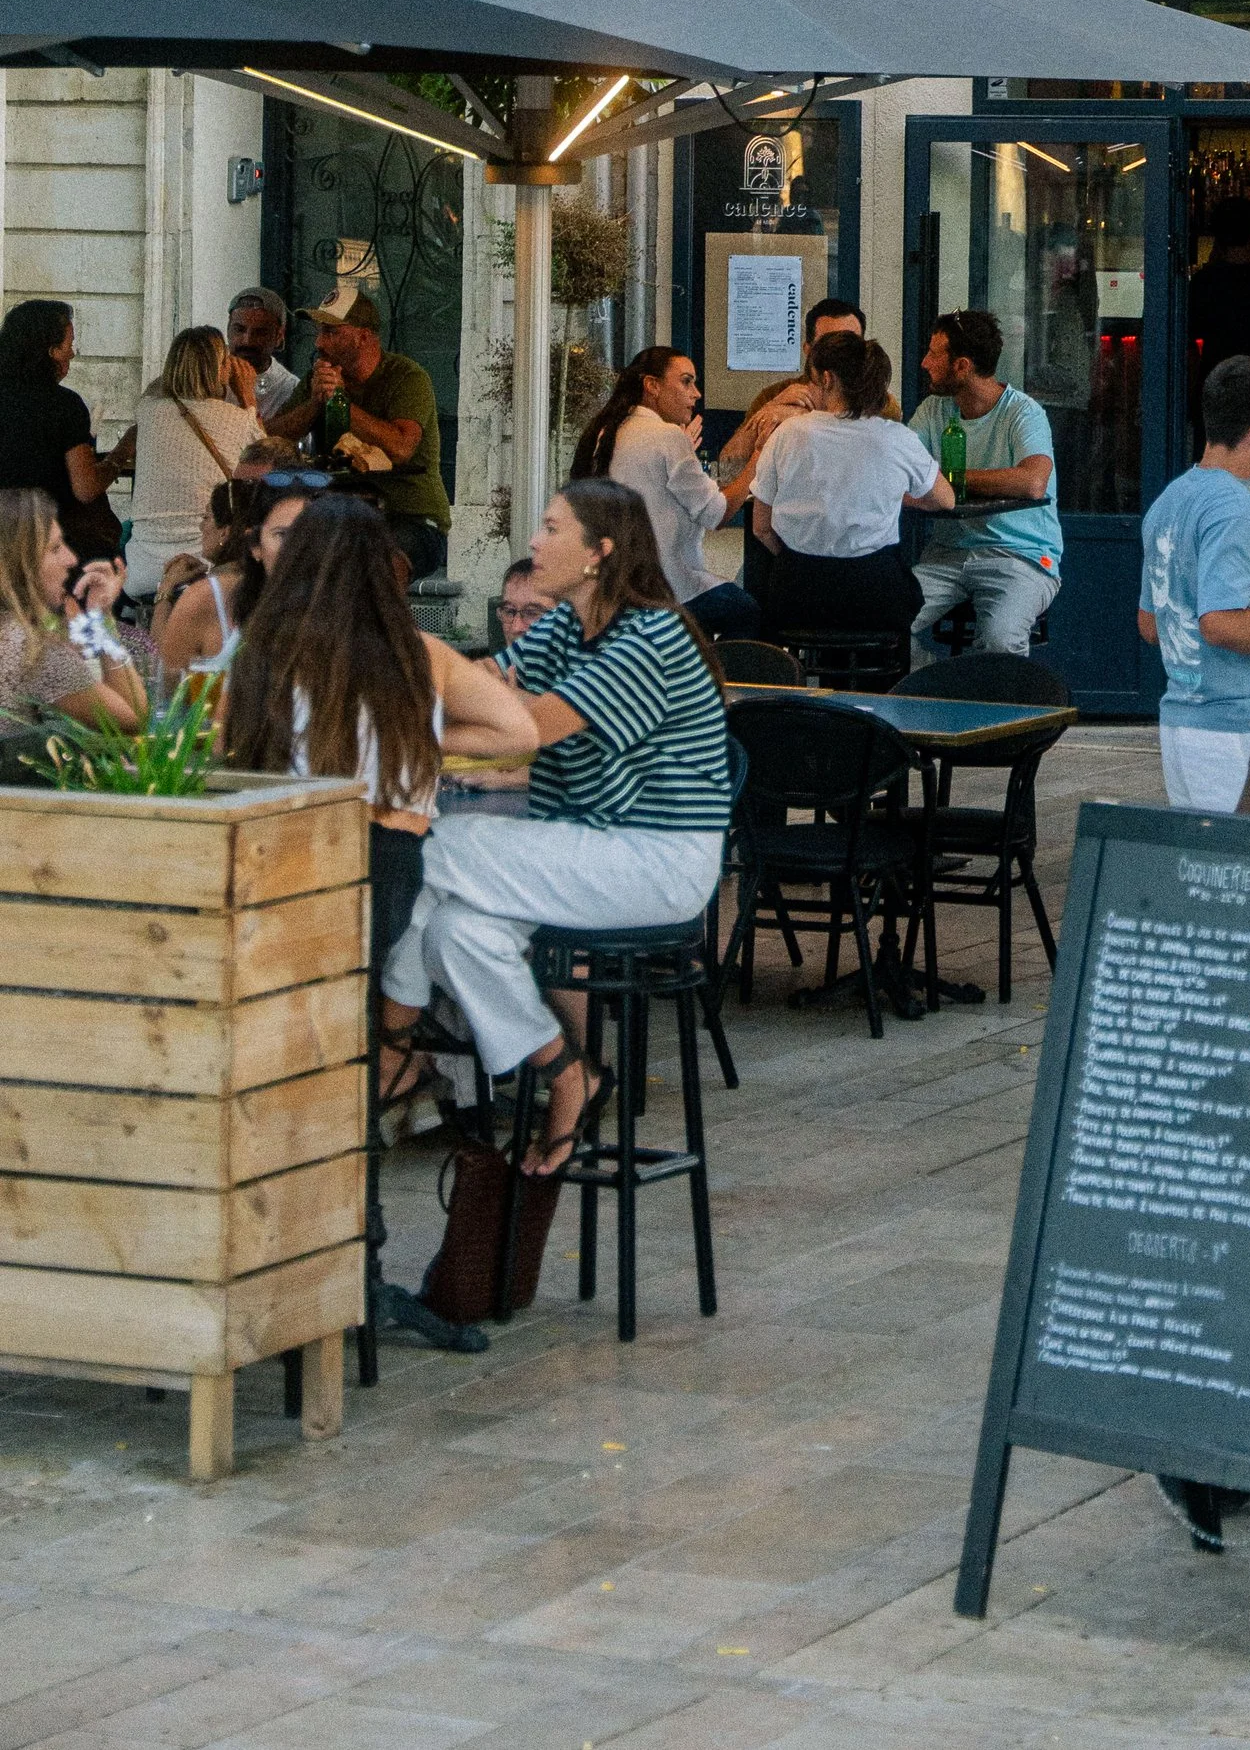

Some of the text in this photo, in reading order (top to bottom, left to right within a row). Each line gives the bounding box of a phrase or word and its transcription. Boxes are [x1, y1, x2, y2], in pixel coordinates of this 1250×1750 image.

[724, 196, 807, 217] cadence
[787, 283, 799, 345] cadence
[1127, 1231, 1196, 1263] DESSERTS
